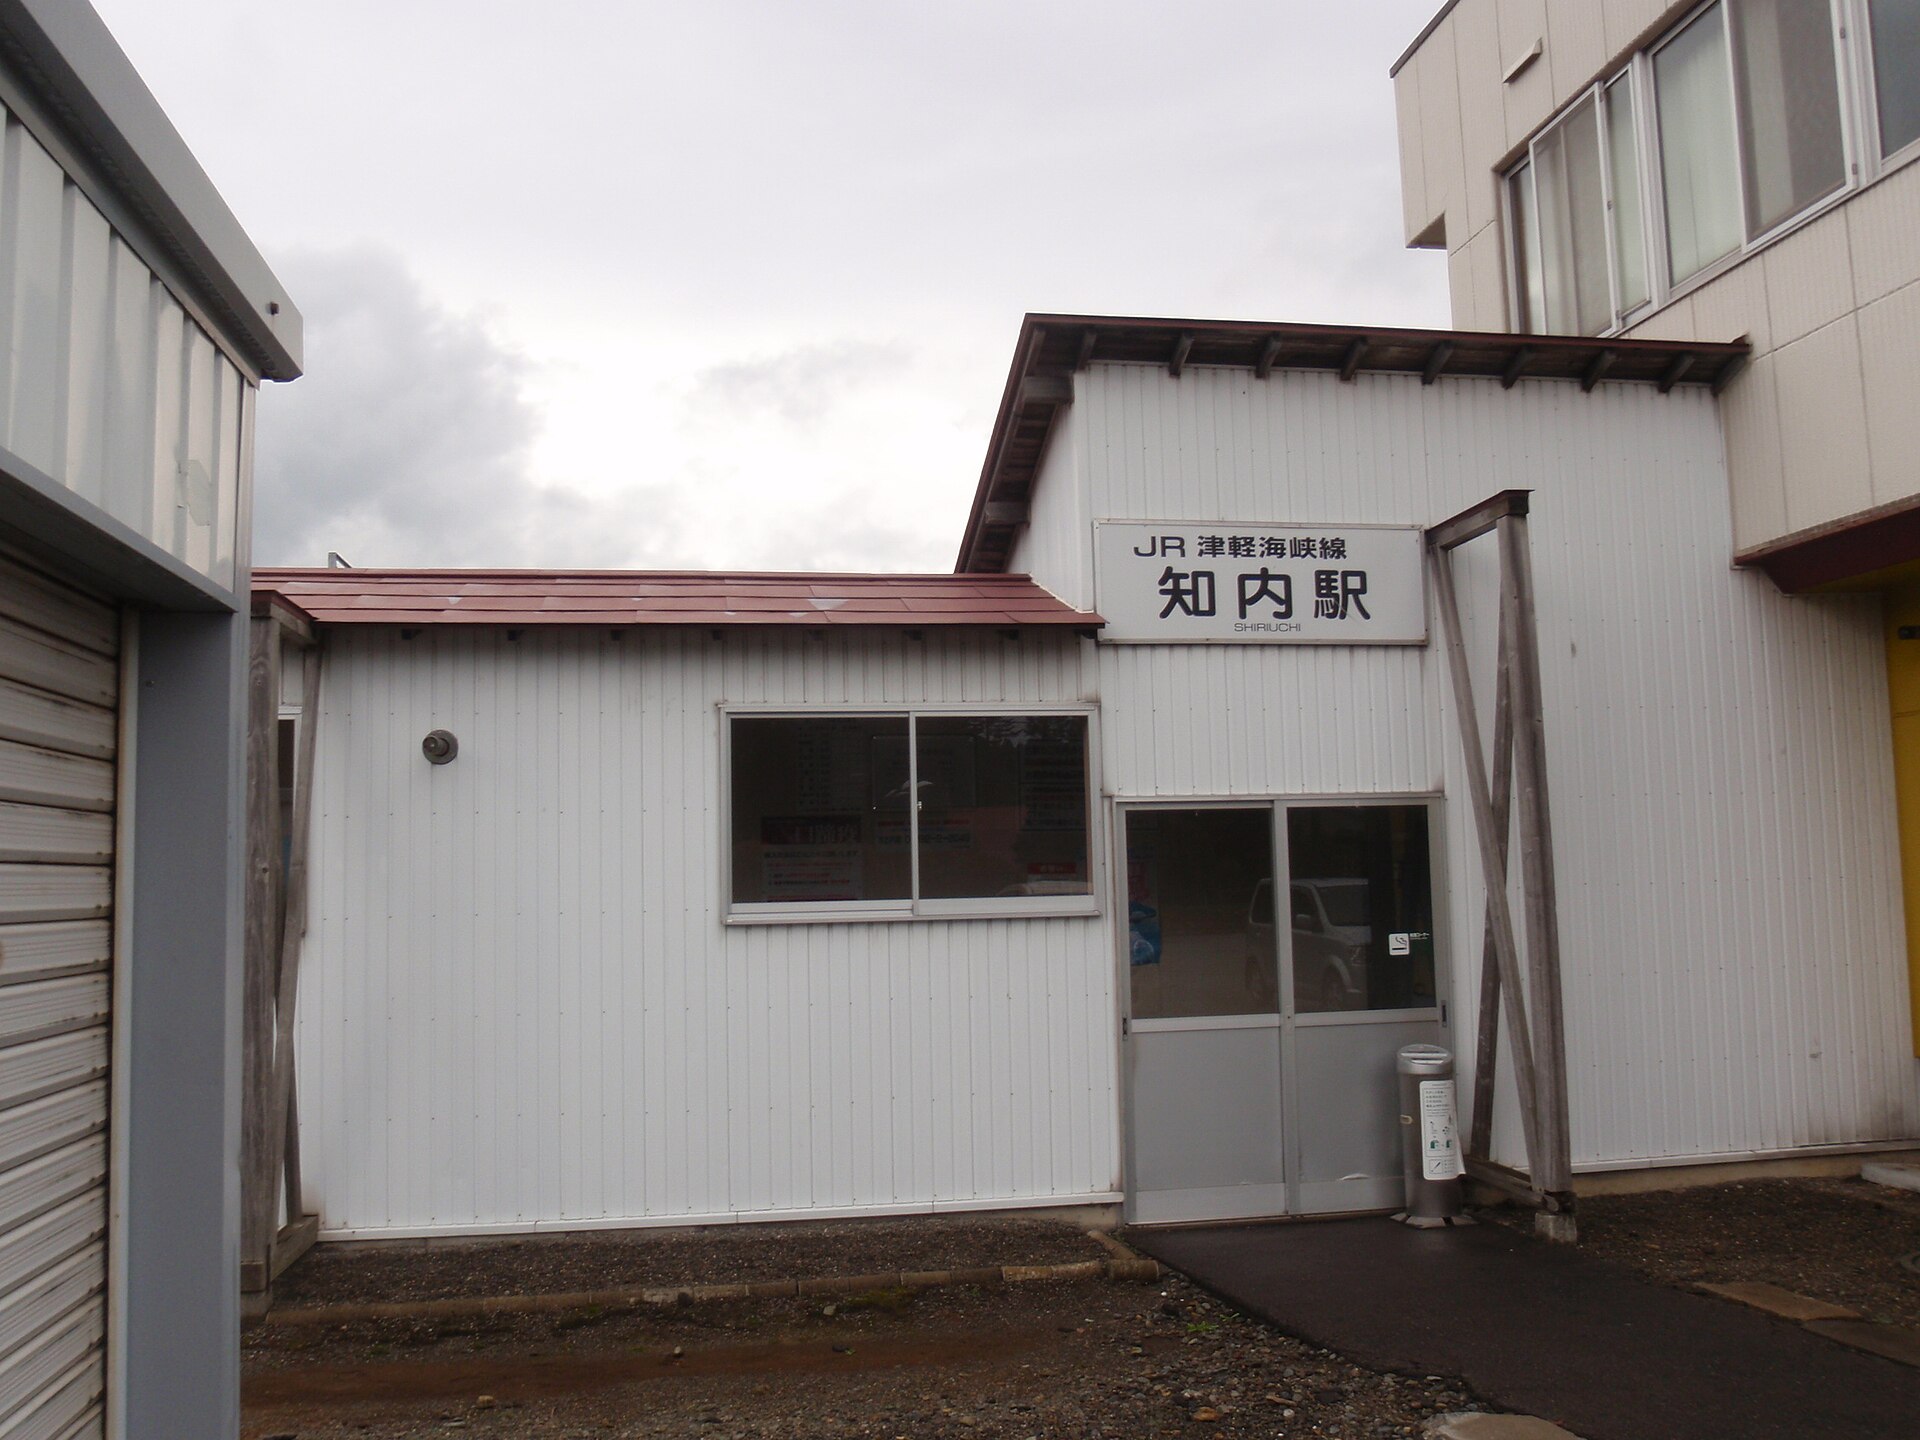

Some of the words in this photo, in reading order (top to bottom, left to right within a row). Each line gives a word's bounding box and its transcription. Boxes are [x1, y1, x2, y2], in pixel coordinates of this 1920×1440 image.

[1134, 536, 1185, 557] JR
[1198, 535, 1347, 559] 津軽海峡線
[1158, 566, 1370, 620] 知内駅
[1234, 622, 1301, 632] SHIRIUCHI
